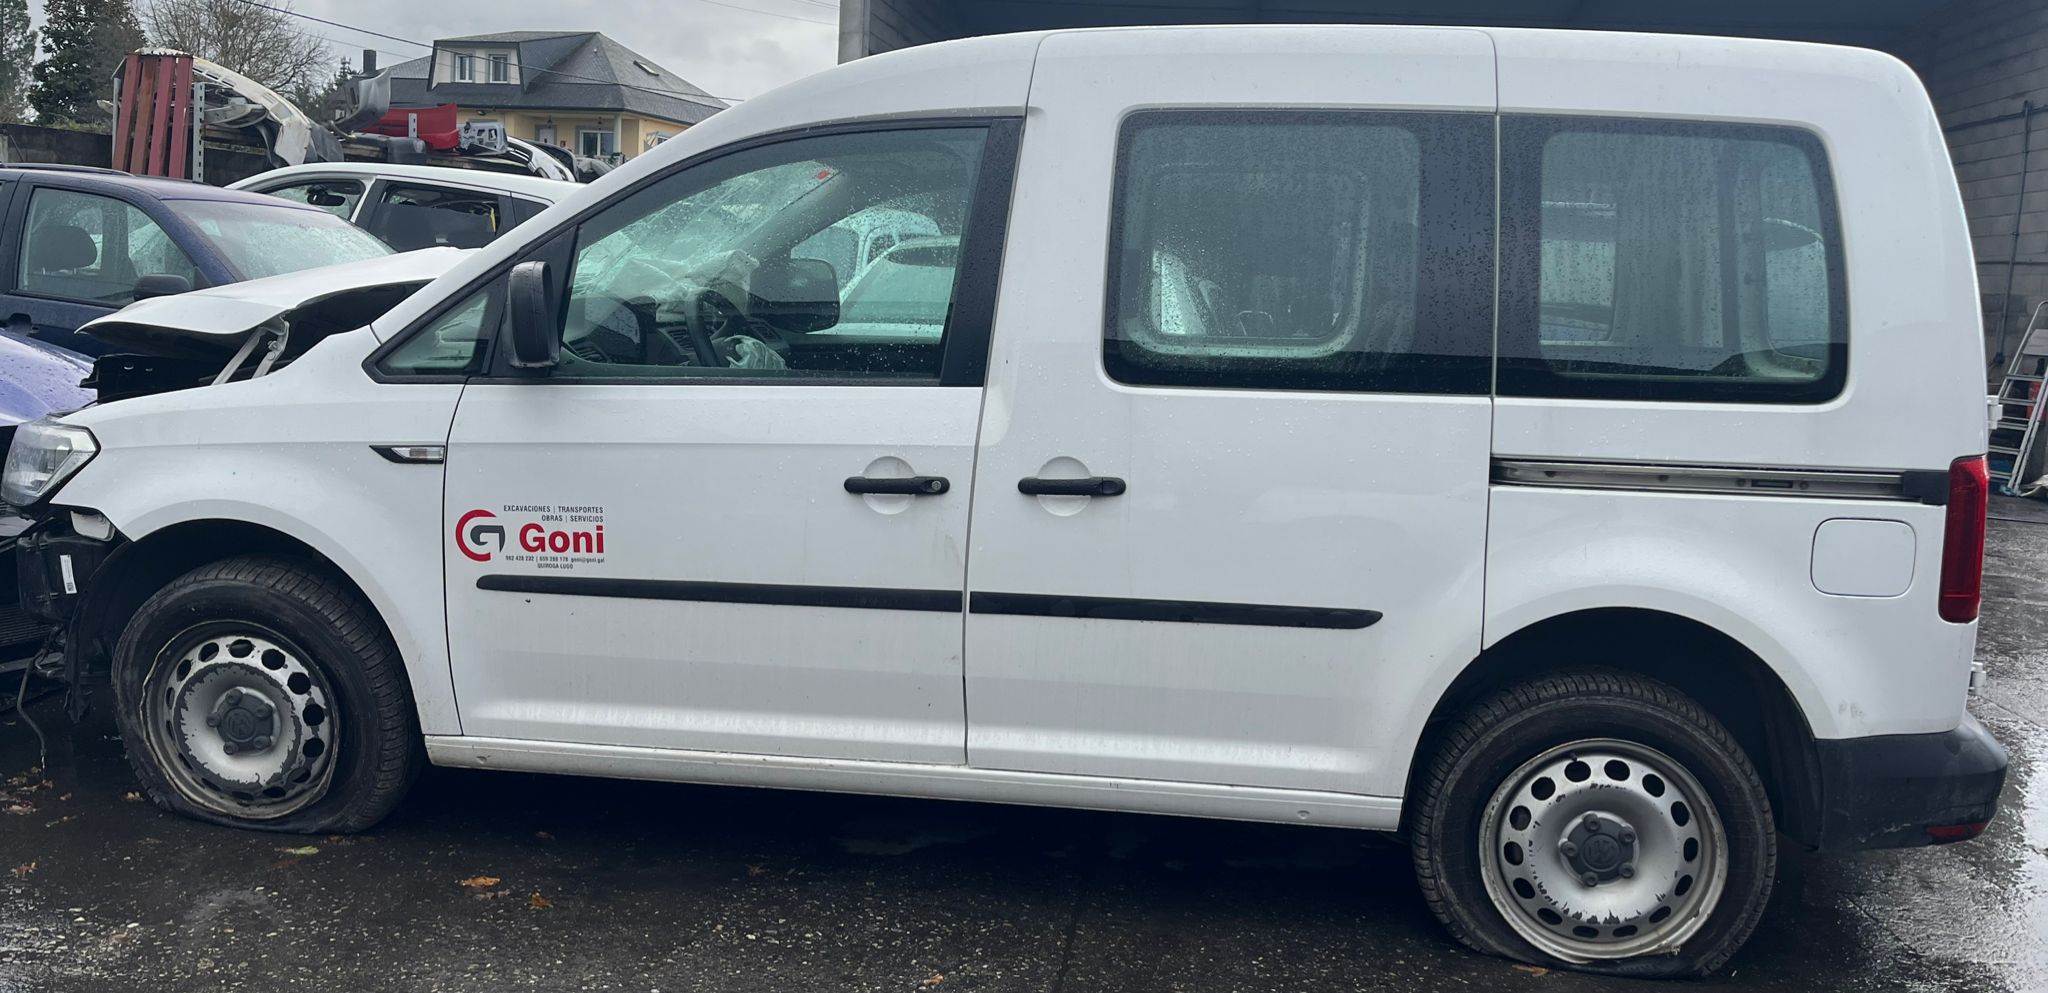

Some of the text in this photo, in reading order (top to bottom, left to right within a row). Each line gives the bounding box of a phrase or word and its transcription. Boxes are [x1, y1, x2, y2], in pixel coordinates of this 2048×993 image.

[503, 505, 604, 514] EXCAVACIONES TRANSPORTES
[570, 515, 604, 523] SERVICIOS
[519, 522, 605, 554] Goni
